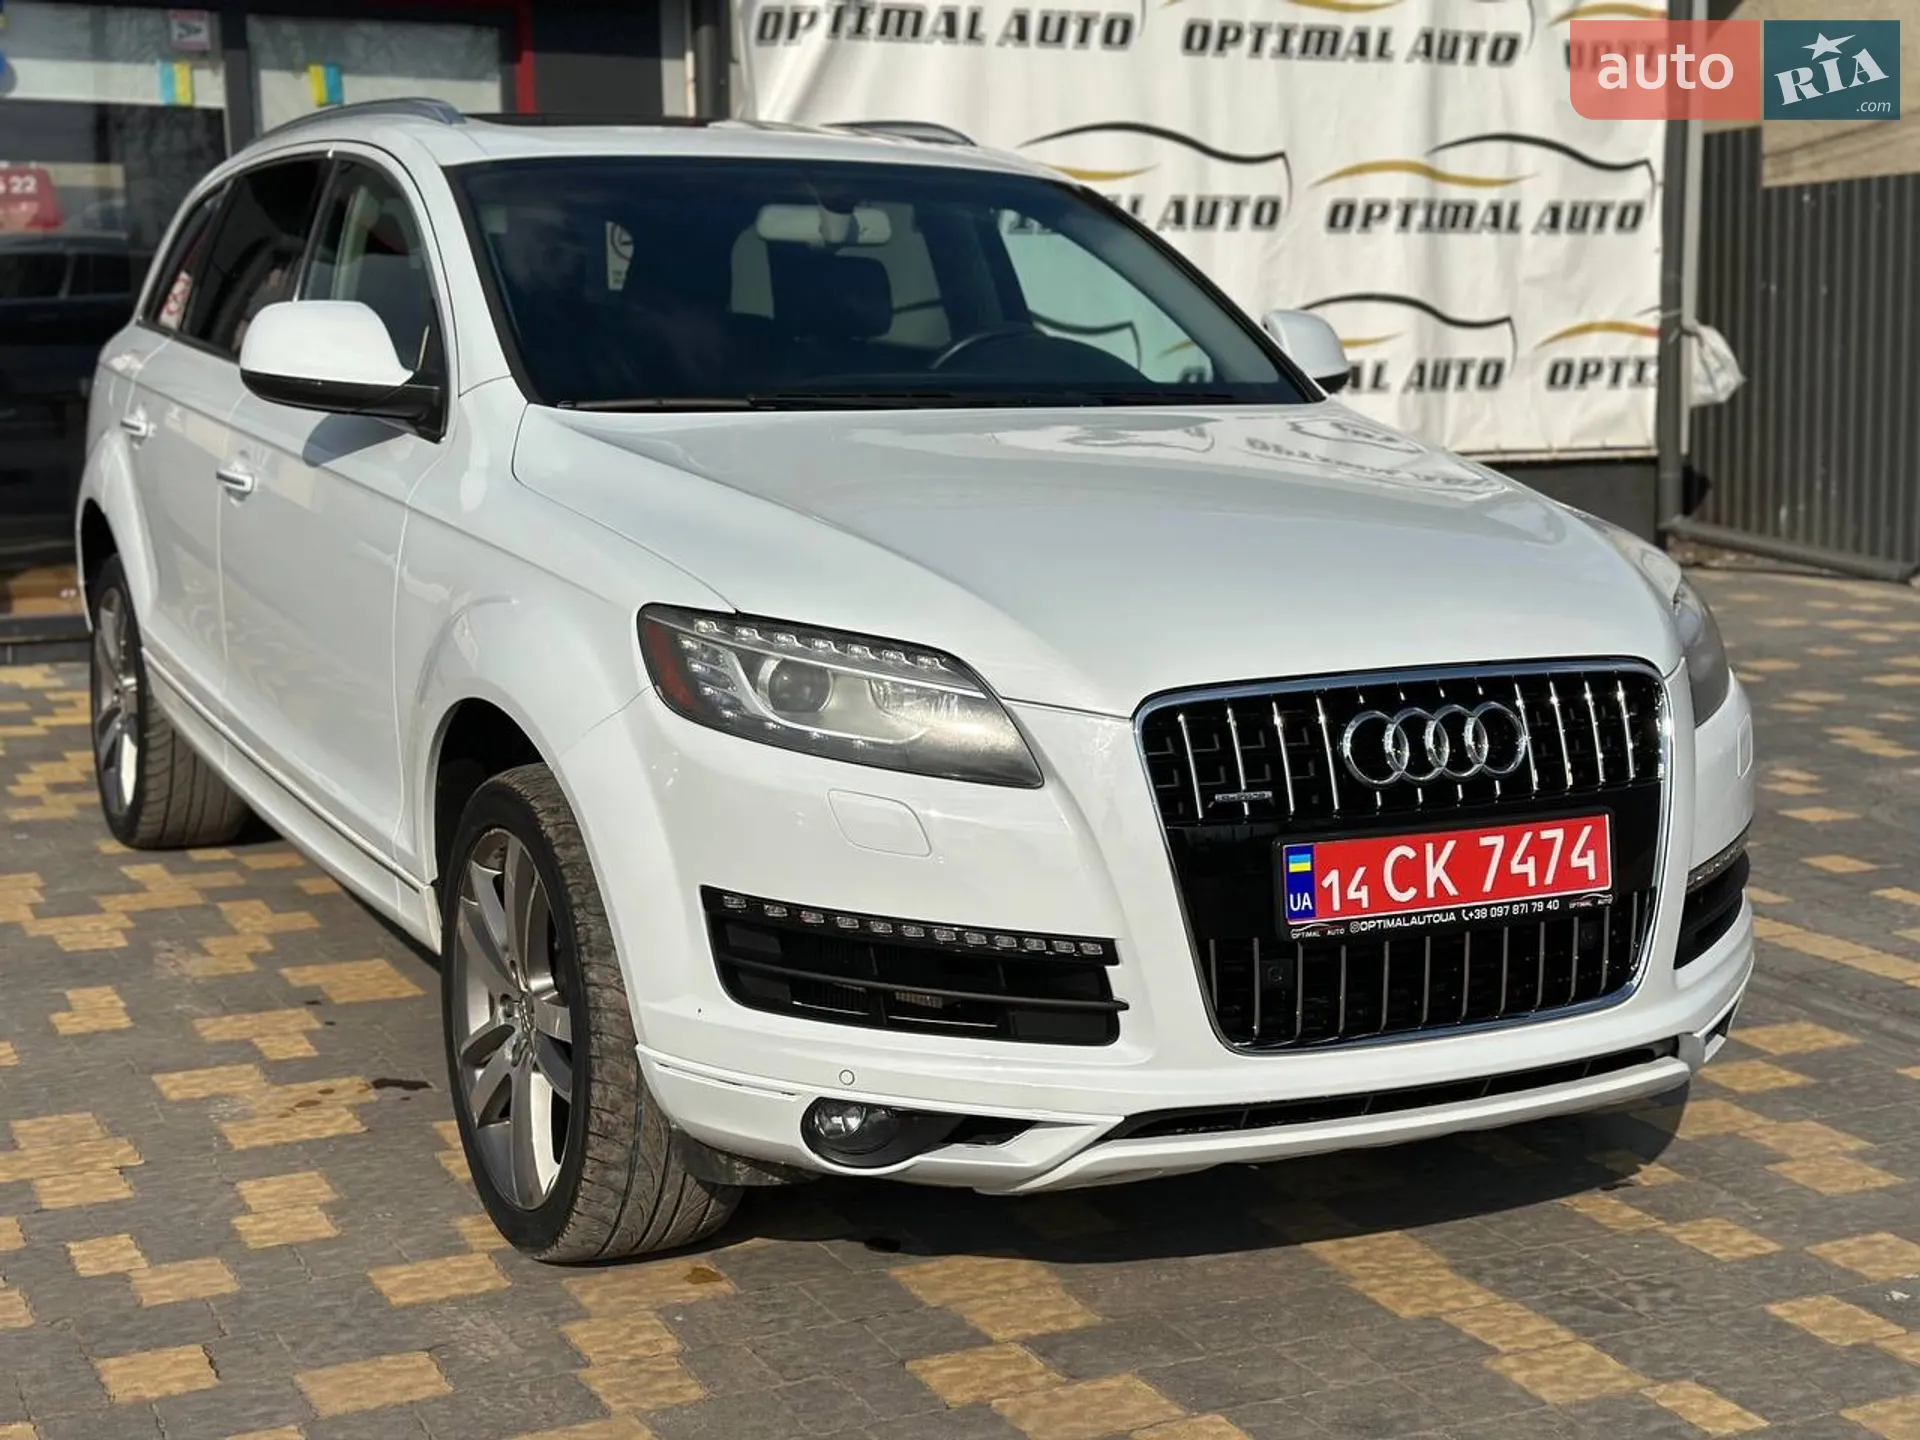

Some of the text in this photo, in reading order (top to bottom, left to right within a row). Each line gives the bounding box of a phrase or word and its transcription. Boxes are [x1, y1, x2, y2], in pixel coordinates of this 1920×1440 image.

[755, 2, 1135, 51] OPTIMAL AUTO
[1181, 17, 1523, 68] OPTIMAL AUTO
[1157, 194, 1282, 232] AUTO
[1325, 198, 1645, 235] OPTIMAL AUTO
[1402, 357, 1506, 395] AUTO
[1320, 824, 1597, 911] 14 CK 7474
[1290, 891, 1313, 913] UA
[1489, 904, 1510, 918] 097
[1511, 902, 1528, 915] 871
[1546, 899, 1560, 911] 40
